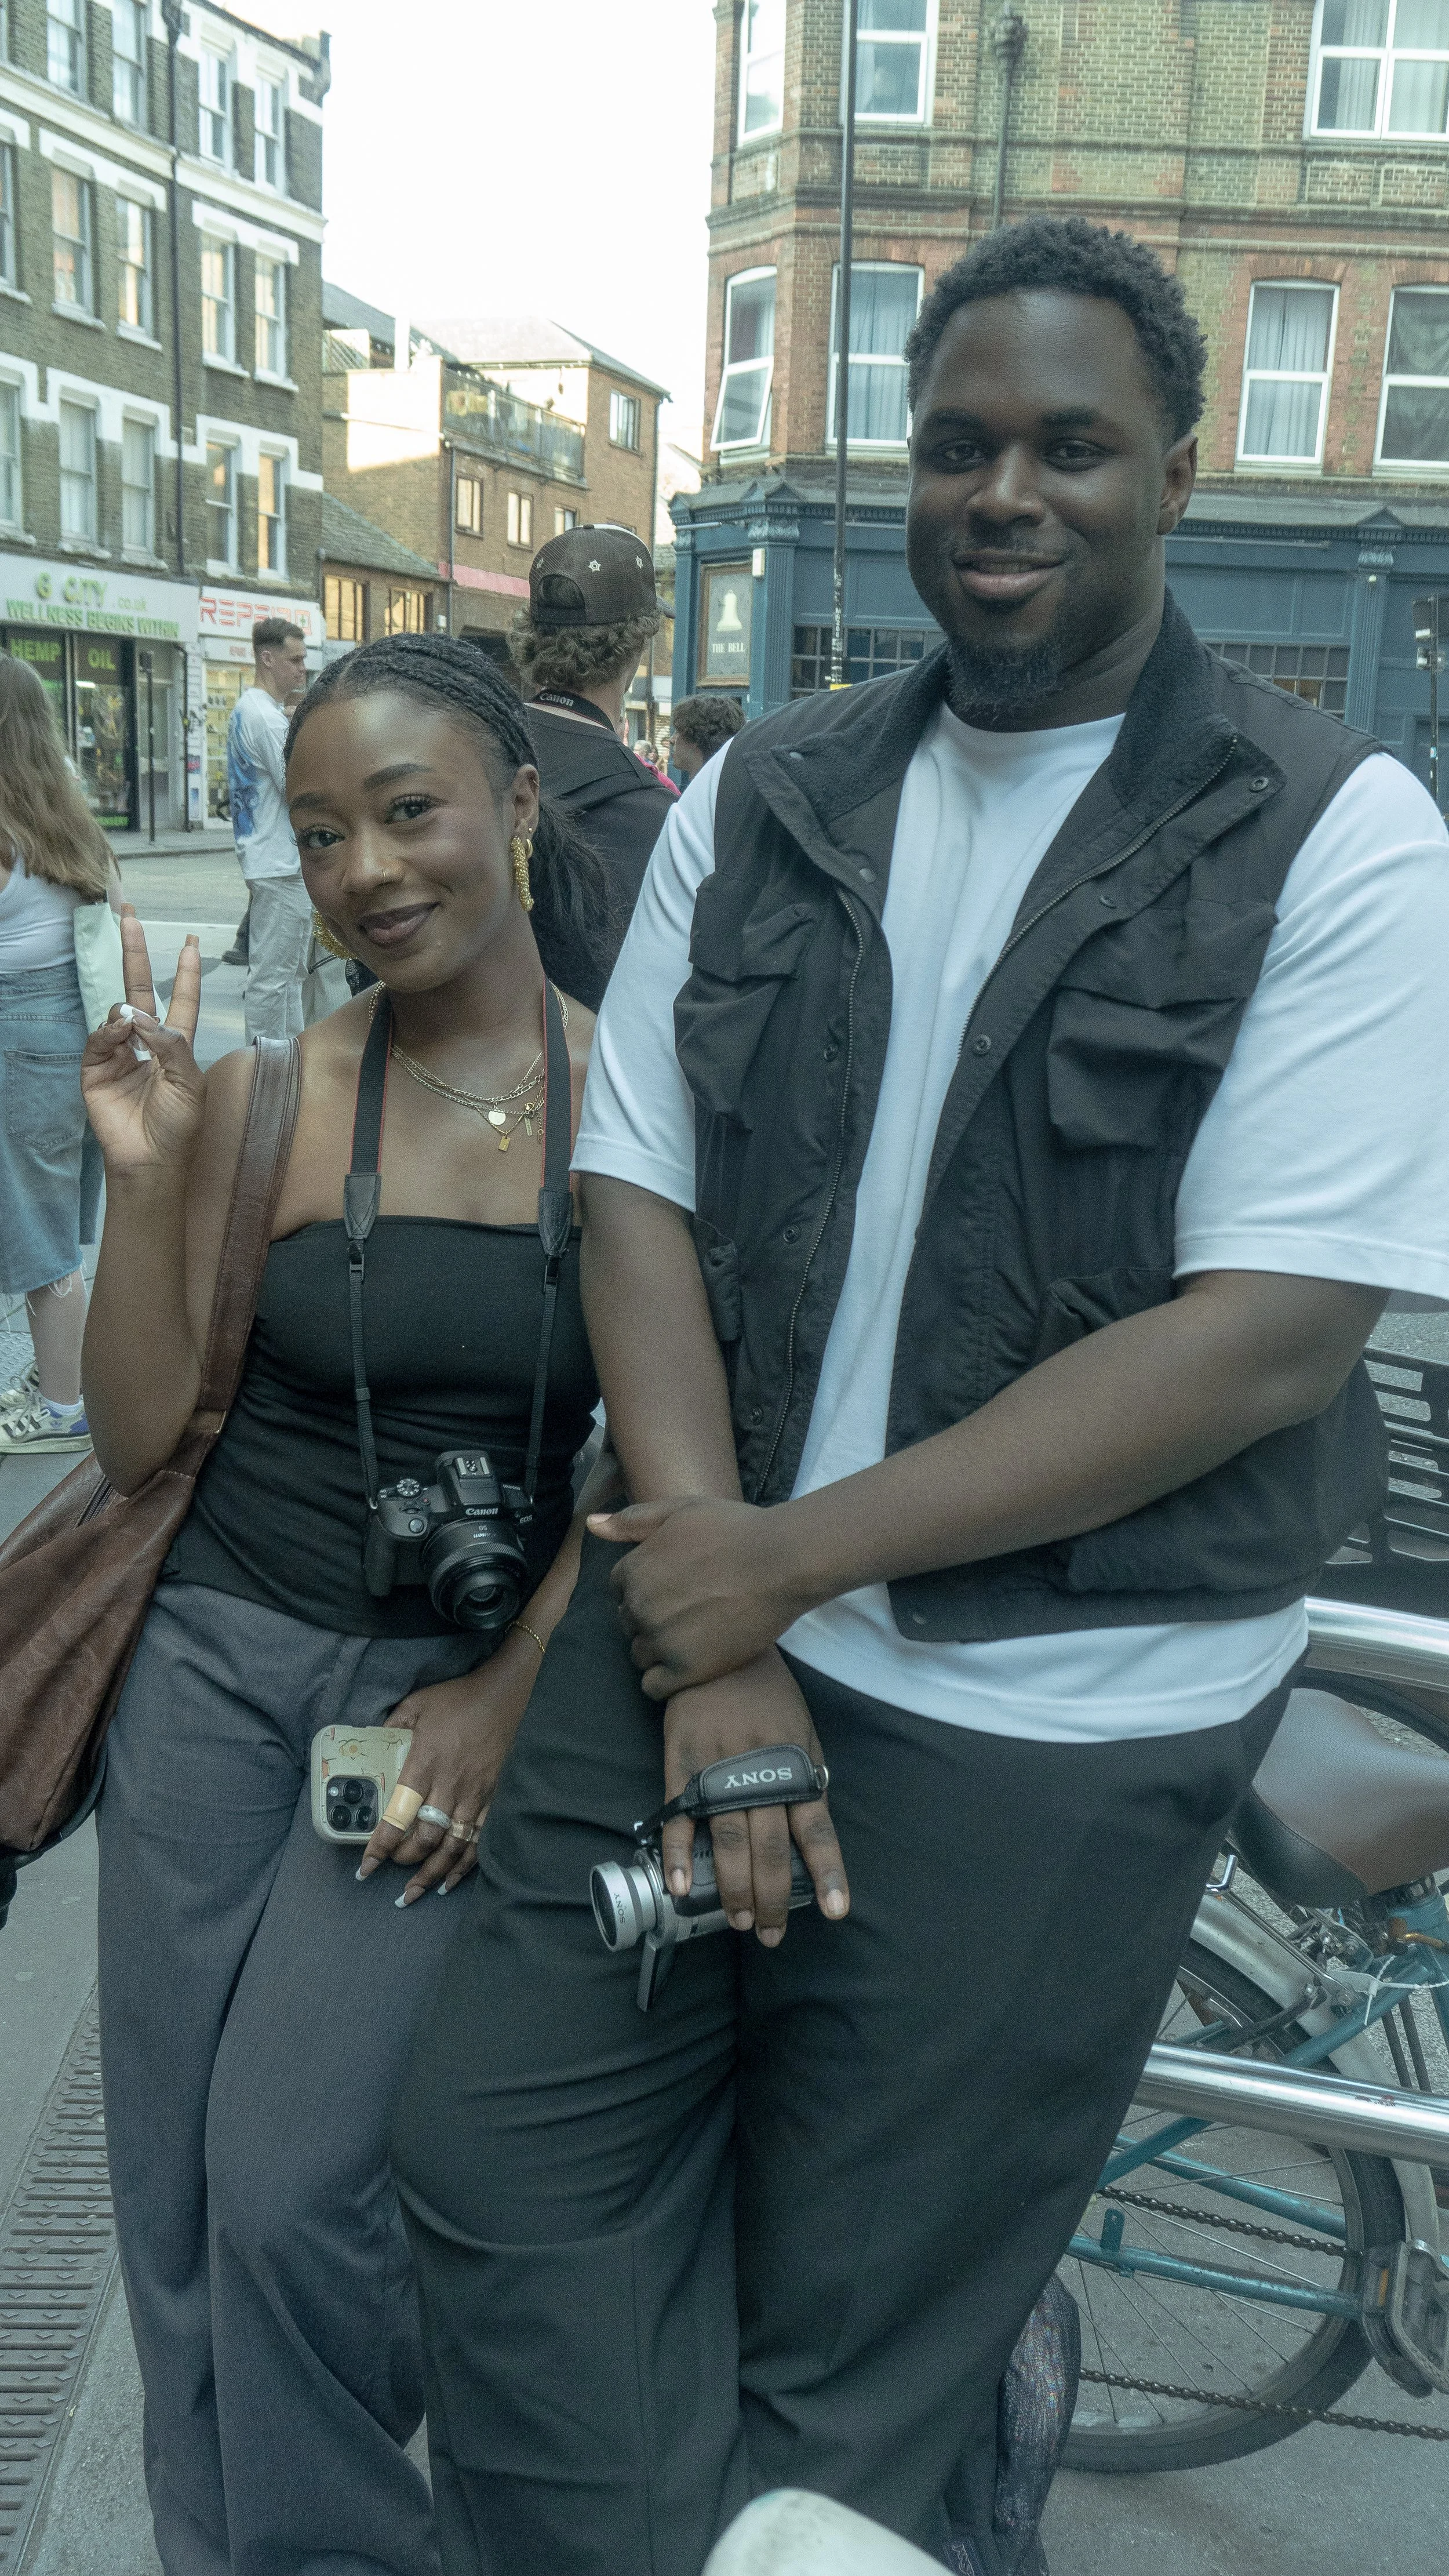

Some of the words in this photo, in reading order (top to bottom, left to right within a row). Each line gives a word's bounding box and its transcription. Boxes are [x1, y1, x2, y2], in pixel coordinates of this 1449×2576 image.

[64, 576, 107, 606] CITY
[6, 598, 83, 626] WELLNESS
[88, 610, 137, 634] BEGINS
[137, 616, 180, 641] WITHIN
[10, 638, 61, 662] HEMP
[88, 647, 116, 670] OIL
[712, 642, 725, 653] THE
[728, 641, 745, 653] BELL
[540, 693, 574, 707] Canon
[519, 1514, 533, 1523] EOS
[724, 1767, 792, 1789] SONY
[614, 1892, 626, 1924] SONY
